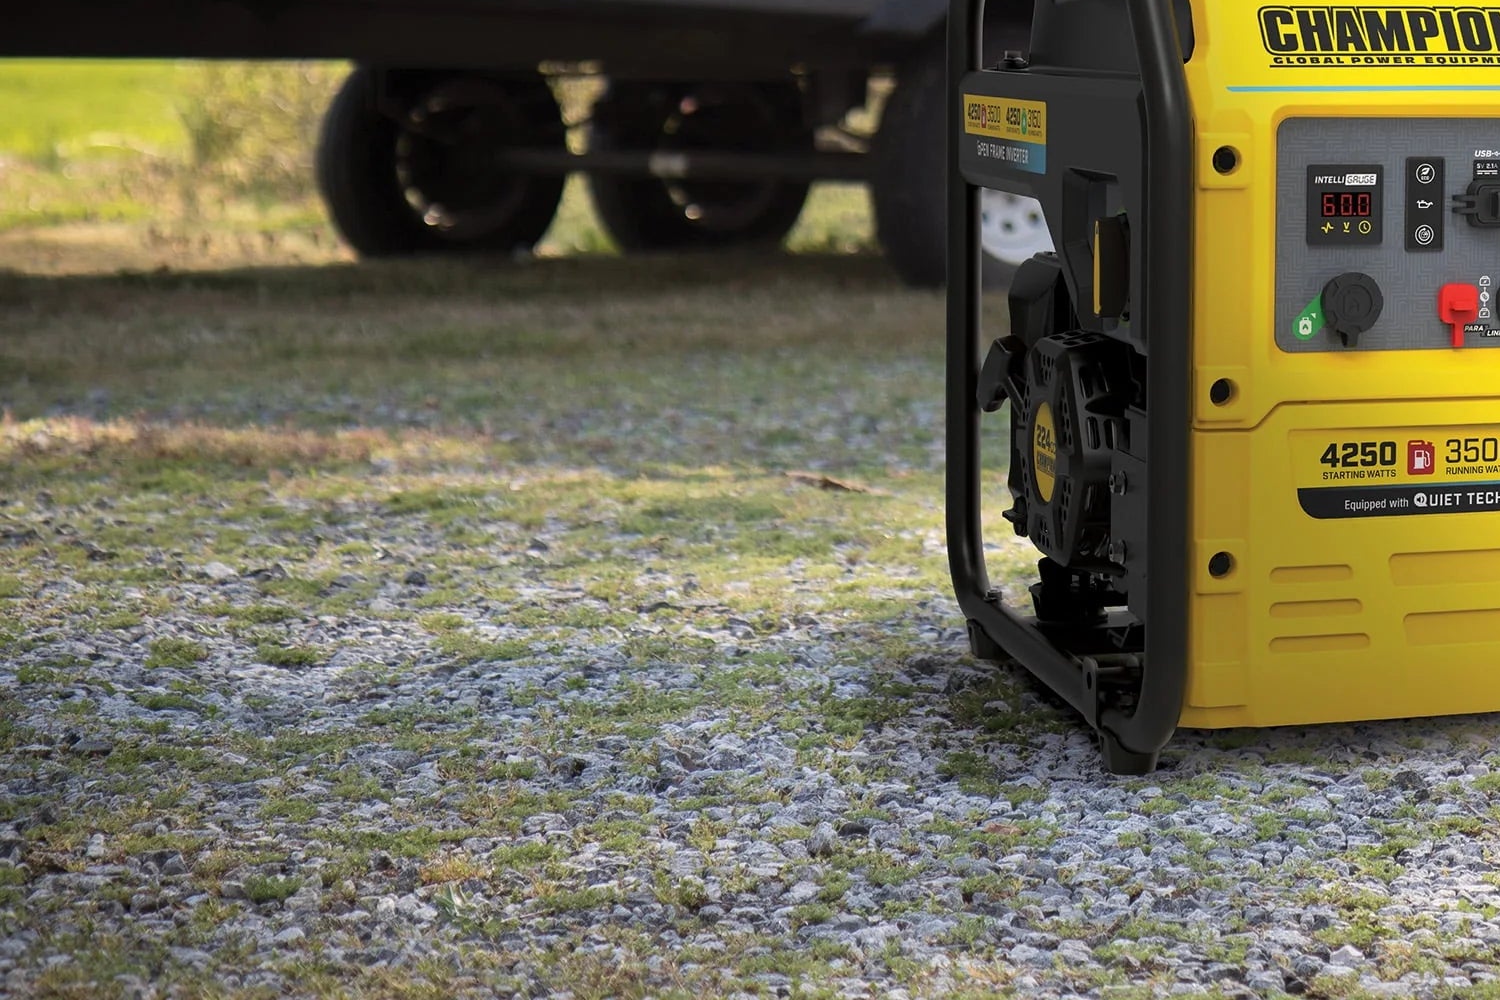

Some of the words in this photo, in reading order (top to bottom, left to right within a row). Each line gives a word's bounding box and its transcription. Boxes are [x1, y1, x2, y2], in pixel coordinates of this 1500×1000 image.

[1273, 56, 1345, 65] GLOBAL
[1351, 56, 1416, 65] POWER
[990, 143, 1006, 160] FRAME
[1474, 150, 1492, 158] USB
[1323, 194, 1370, 216] 60.0
[1320, 441, 1396, 468] 4250
[1322, 470, 1366, 480] STARTING
[1367, 469, 1397, 478] WATTS
[1445, 466, 1484, 475] RUNNING
[1344, 499, 1387, 511] Equipped
[1389, 498, 1409, 507] with
[1413, 492, 1461, 508] QUIET
